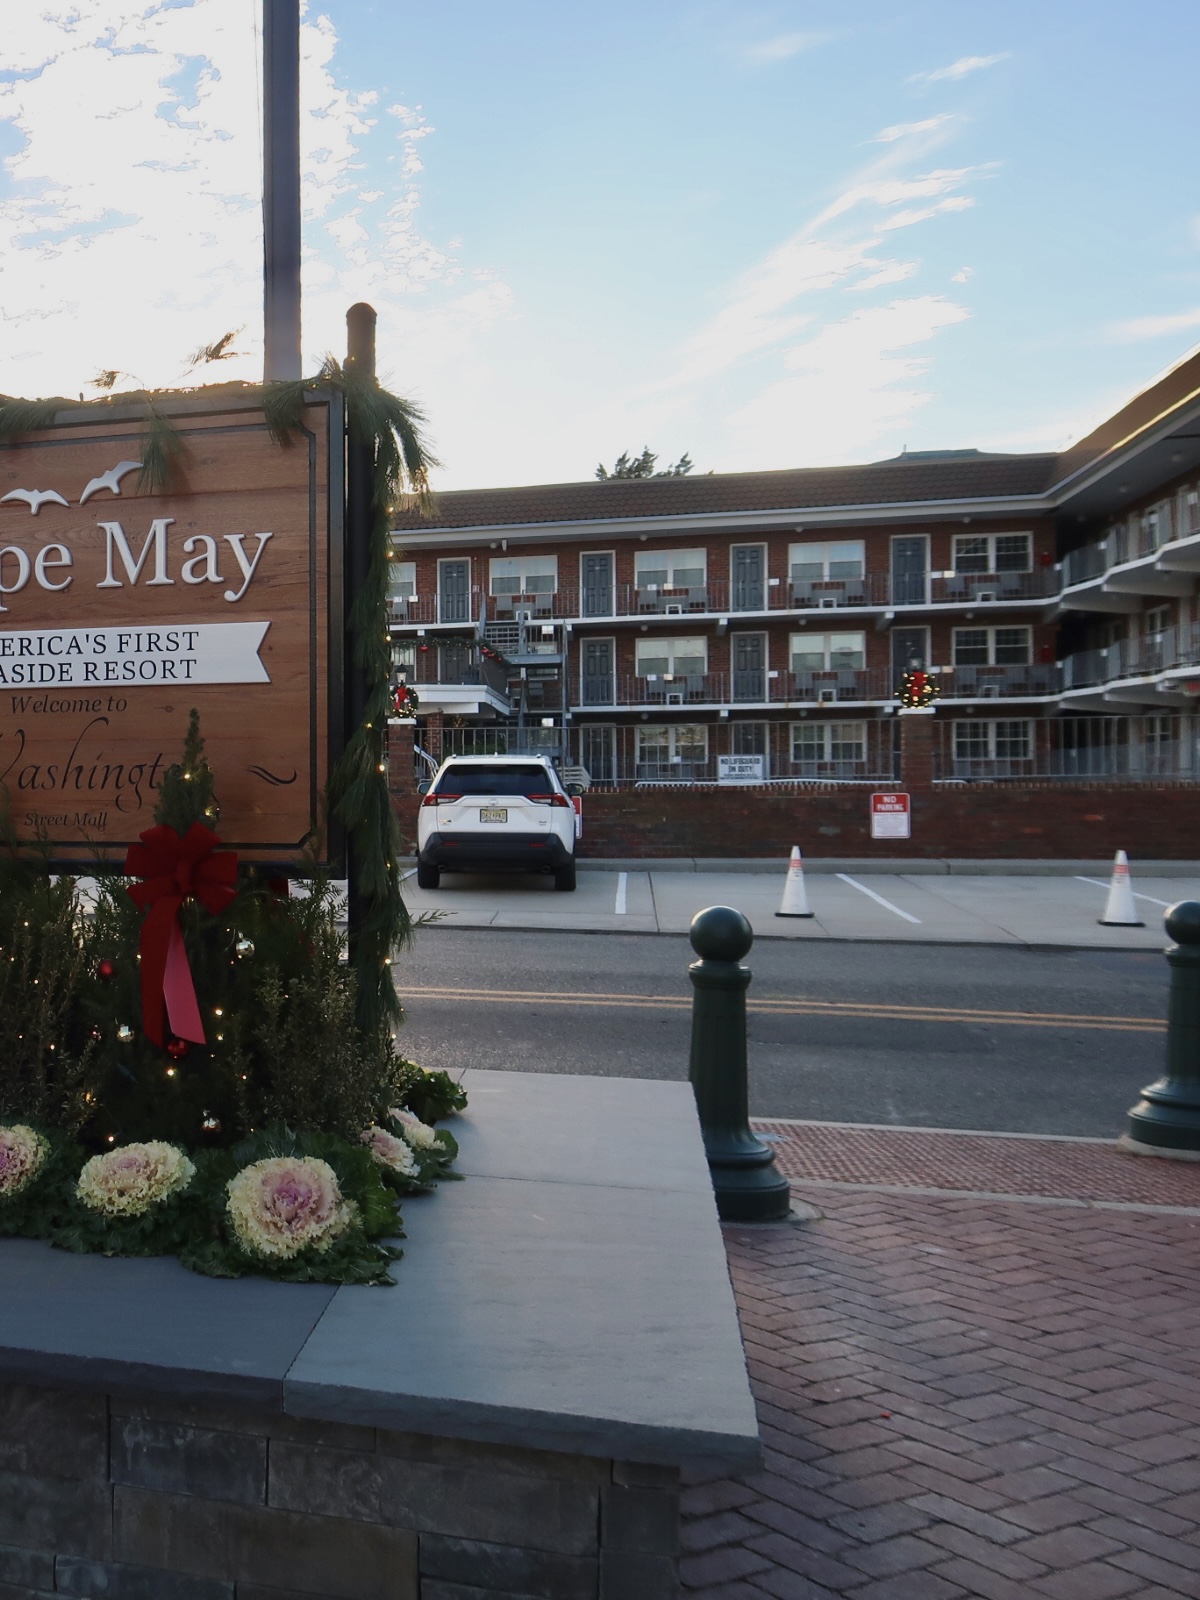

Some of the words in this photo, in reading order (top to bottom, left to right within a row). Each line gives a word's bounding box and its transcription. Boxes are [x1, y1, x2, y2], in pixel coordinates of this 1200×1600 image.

[95, 518, 274, 603] May
[116, 631, 200, 653] FIRST
[83, 659, 197, 681] RESORT
[11, 694, 102, 714] Welcome
[107, 696, 128, 712] to
[876, 803, 905, 811] PARKING
[882, 795, 897, 804] NO
[23, 812, 69, 827] Street
[73, 811, 108, 828] Mall
